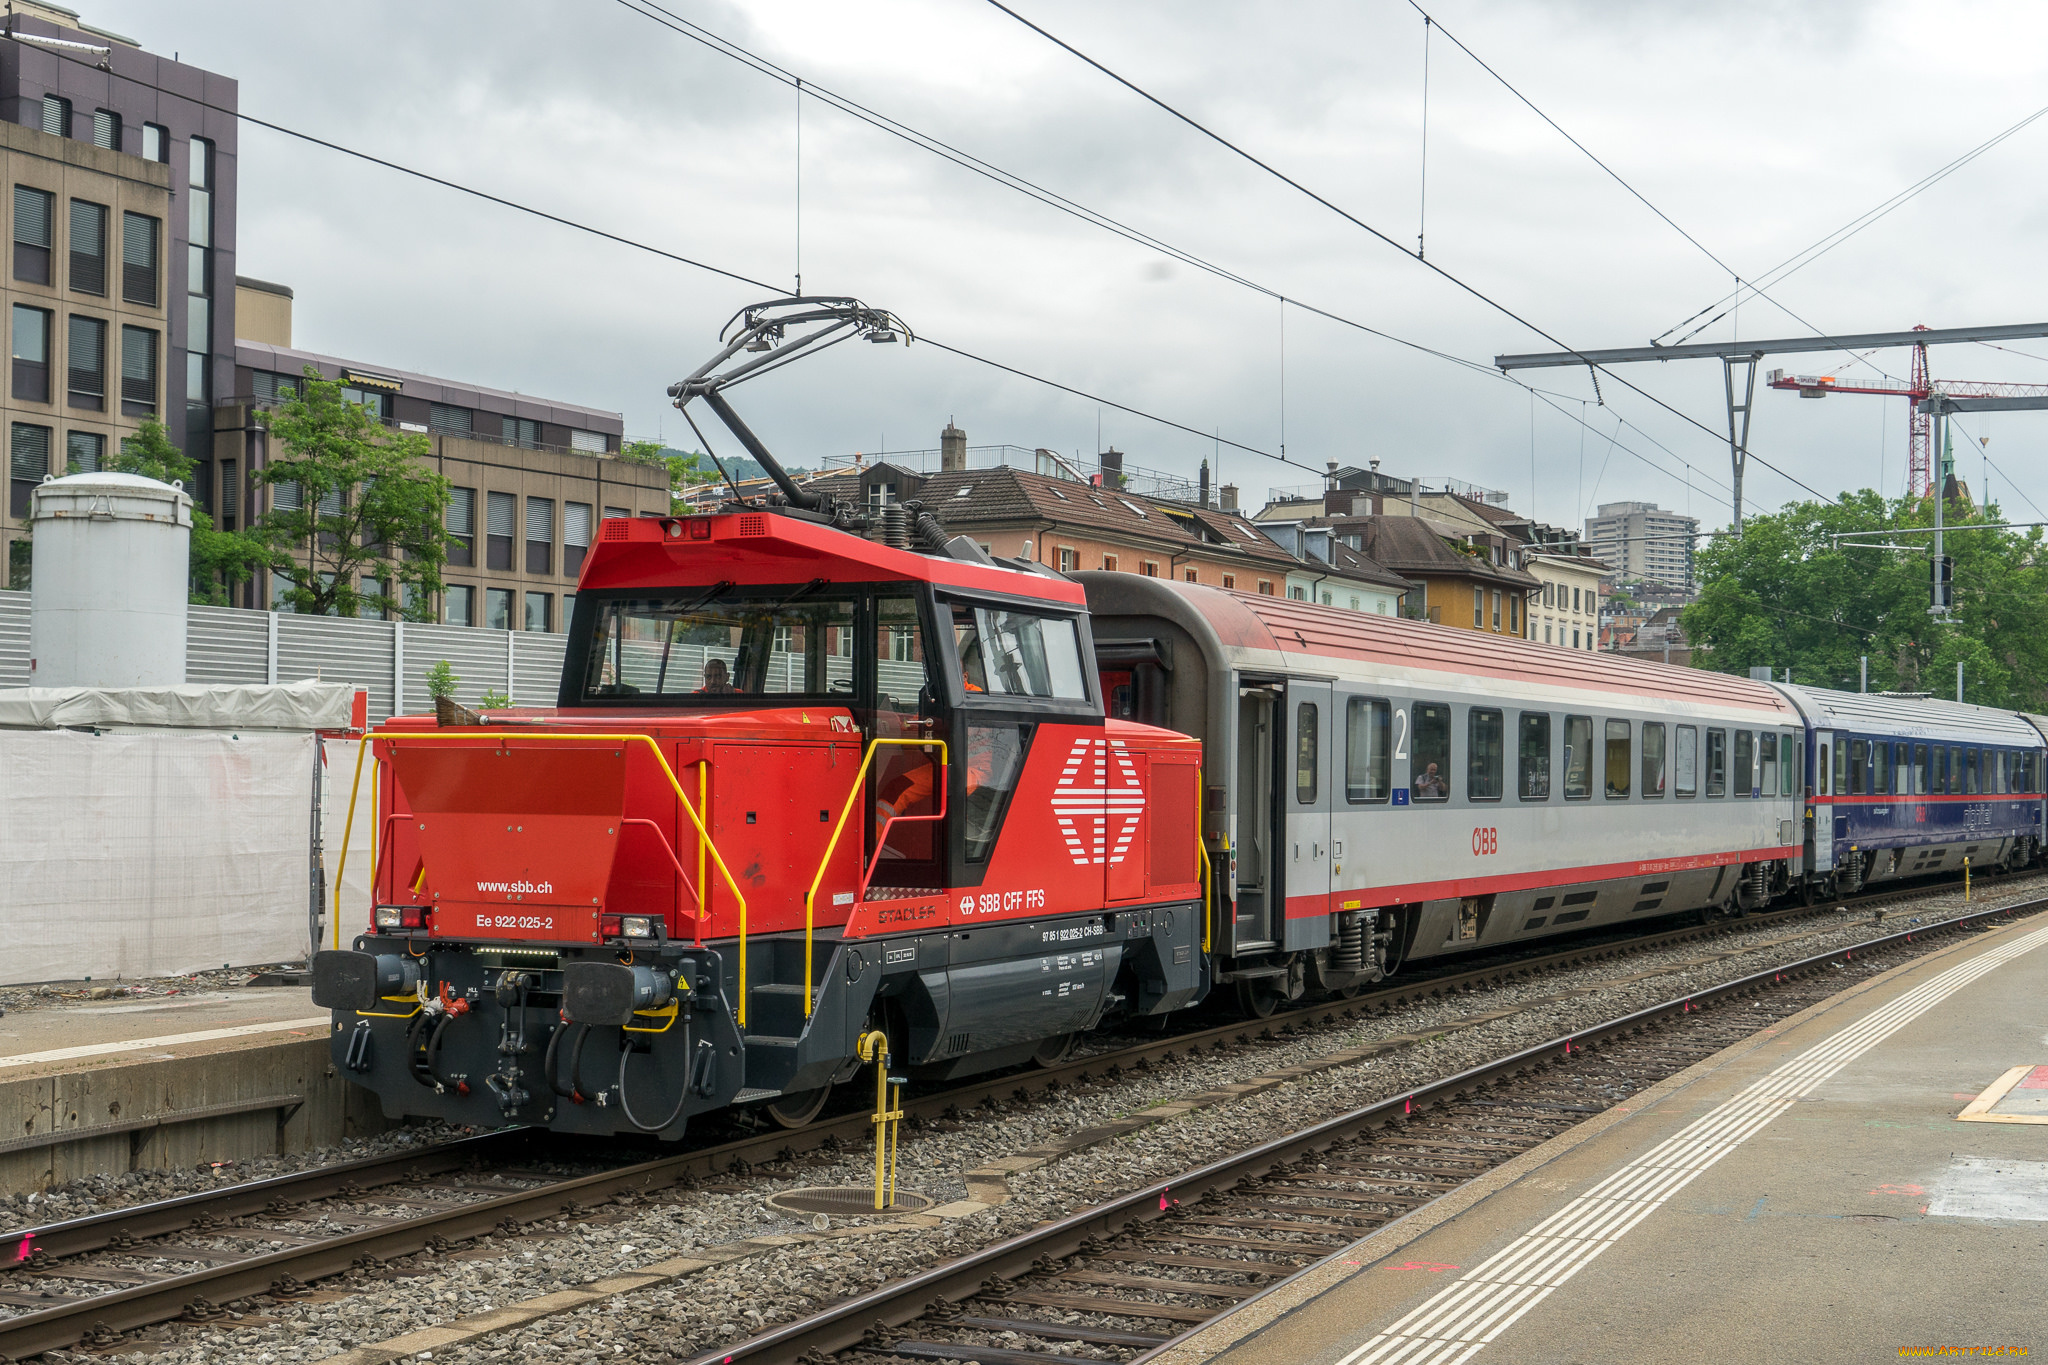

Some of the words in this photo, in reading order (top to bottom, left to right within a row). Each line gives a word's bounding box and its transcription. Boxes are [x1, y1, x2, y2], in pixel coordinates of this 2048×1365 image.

[1395, 708, 1407, 760] 2
[1753, 737, 1759, 769] 2
[1867, 740, 1873, 767] 2
[1472, 827, 1497, 856] ÖBB
[477, 881, 553, 894] www.sbb.ch
[979, 893, 1000, 914] SBB
[1003, 891, 1023, 911] CFF
[1026, 889, 1045, 909] FFS
[476, 914, 493, 928] Ee
[495, 915, 517, 928] 922
[519, 916, 553, 930] 025-2
[878, 905, 936, 924] STADLER
[1042, 931, 1049, 942] 97
[1049, 930, 1056, 941] 85
[1060, 928, 1069, 941] 922
[1069, 927, 1083, 939] 025-2
[1084, 925, 1103, 937] CH-SBB
